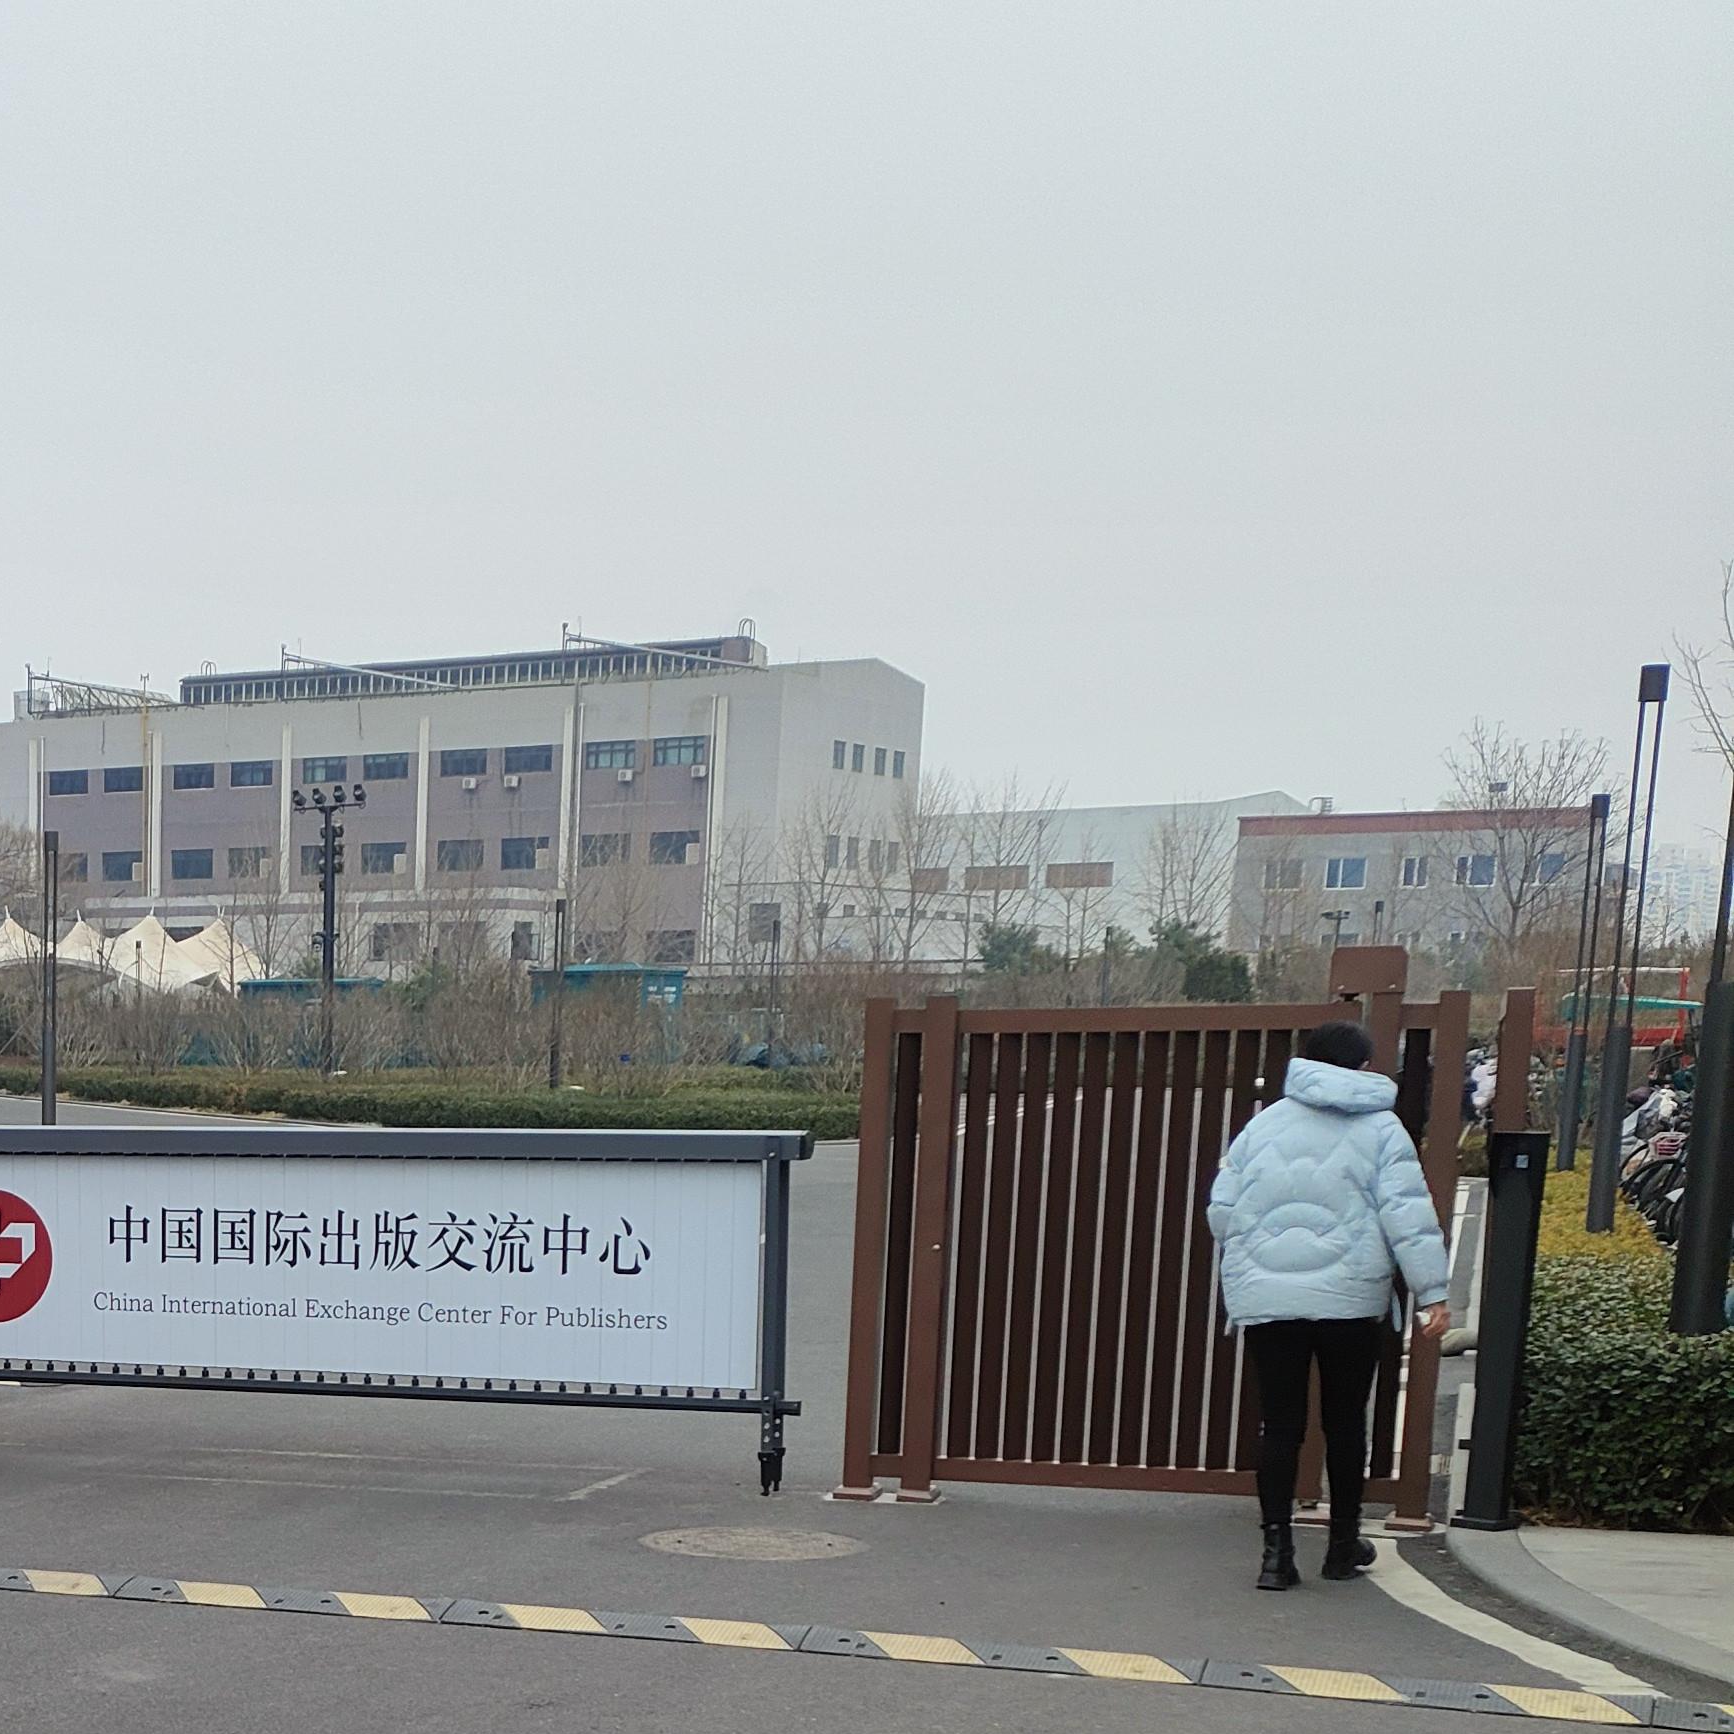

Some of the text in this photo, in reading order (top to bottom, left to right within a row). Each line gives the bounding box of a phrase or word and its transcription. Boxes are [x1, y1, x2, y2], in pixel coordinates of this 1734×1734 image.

[107, 1204, 652, 1277] 中国国际出版交流中心
[93, 1291, 668, 1330] China International Exchange Center For Publishers
